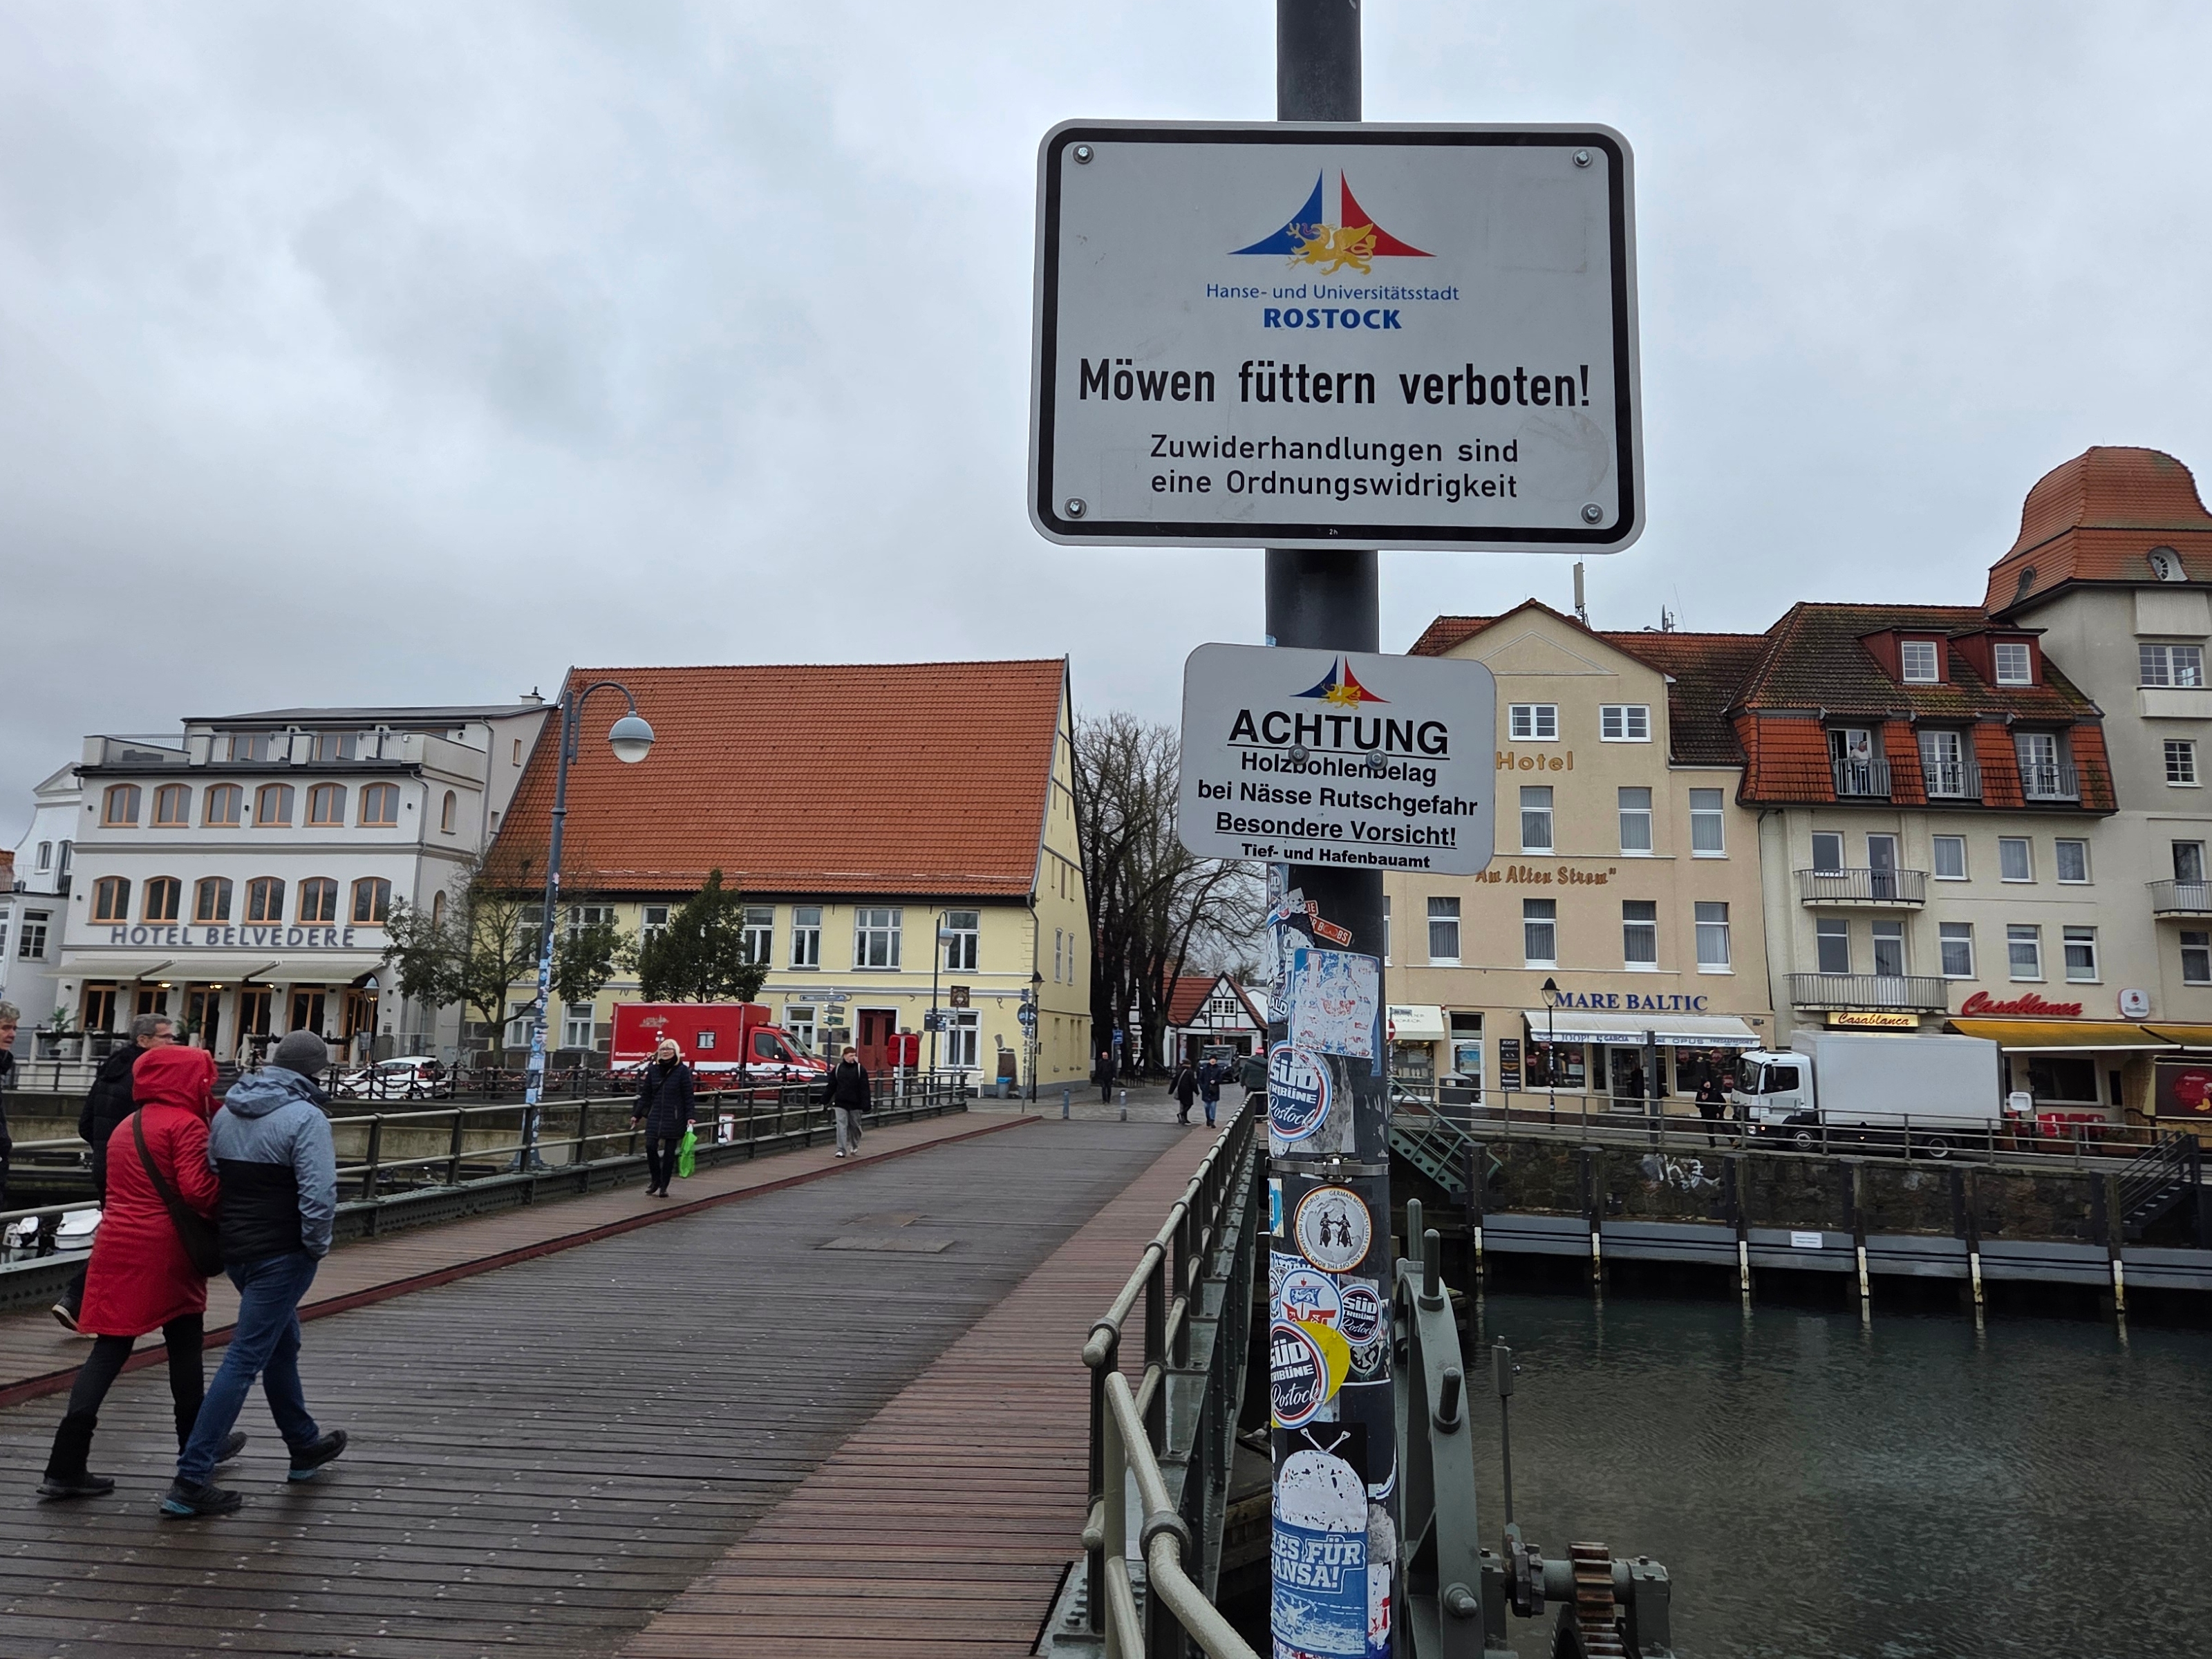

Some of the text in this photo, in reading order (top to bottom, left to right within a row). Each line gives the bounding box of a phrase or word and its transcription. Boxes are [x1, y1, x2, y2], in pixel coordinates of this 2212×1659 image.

[1206, 283, 1459, 300] Hanse- und Universitätsstadt
[1264, 308, 1402, 329] ROSTOCK
[1080, 358, 1590, 406] Möwen füttern verboten!
[1150, 434, 1519, 467] Zuwiderhandlungen sind
[1151, 470, 1517, 503] eine Ordnungswidrigkeit
[1228, 709, 1449, 754] ACHTUNG
[1241, 751, 1436, 787] Holzbohlenbelag
[1496, 751, 1574, 771] Hotel
[1198, 780, 1478, 816] bei Nässe Rutschgefahr
[1216, 812, 1456, 847] Besondere Vorsicht!
[1241, 843, 1430, 868] Tief- und Hafenbauamt
[1506, 865, 1553, 884] Alten
[110, 926, 355, 946] HOTEL BELVEDERE
[1556, 992, 1708, 1011] MARE BALTIC
[1962, 991, 2083, 1016] Casablanca
[1837, 1012, 1911, 1026] Casablanca
[1304, 1194, 1320, 1210] WORLD
[1329, 1190, 1353, 1201] GERMAN
[1306, 1537, 1360, 1565] FÜR
